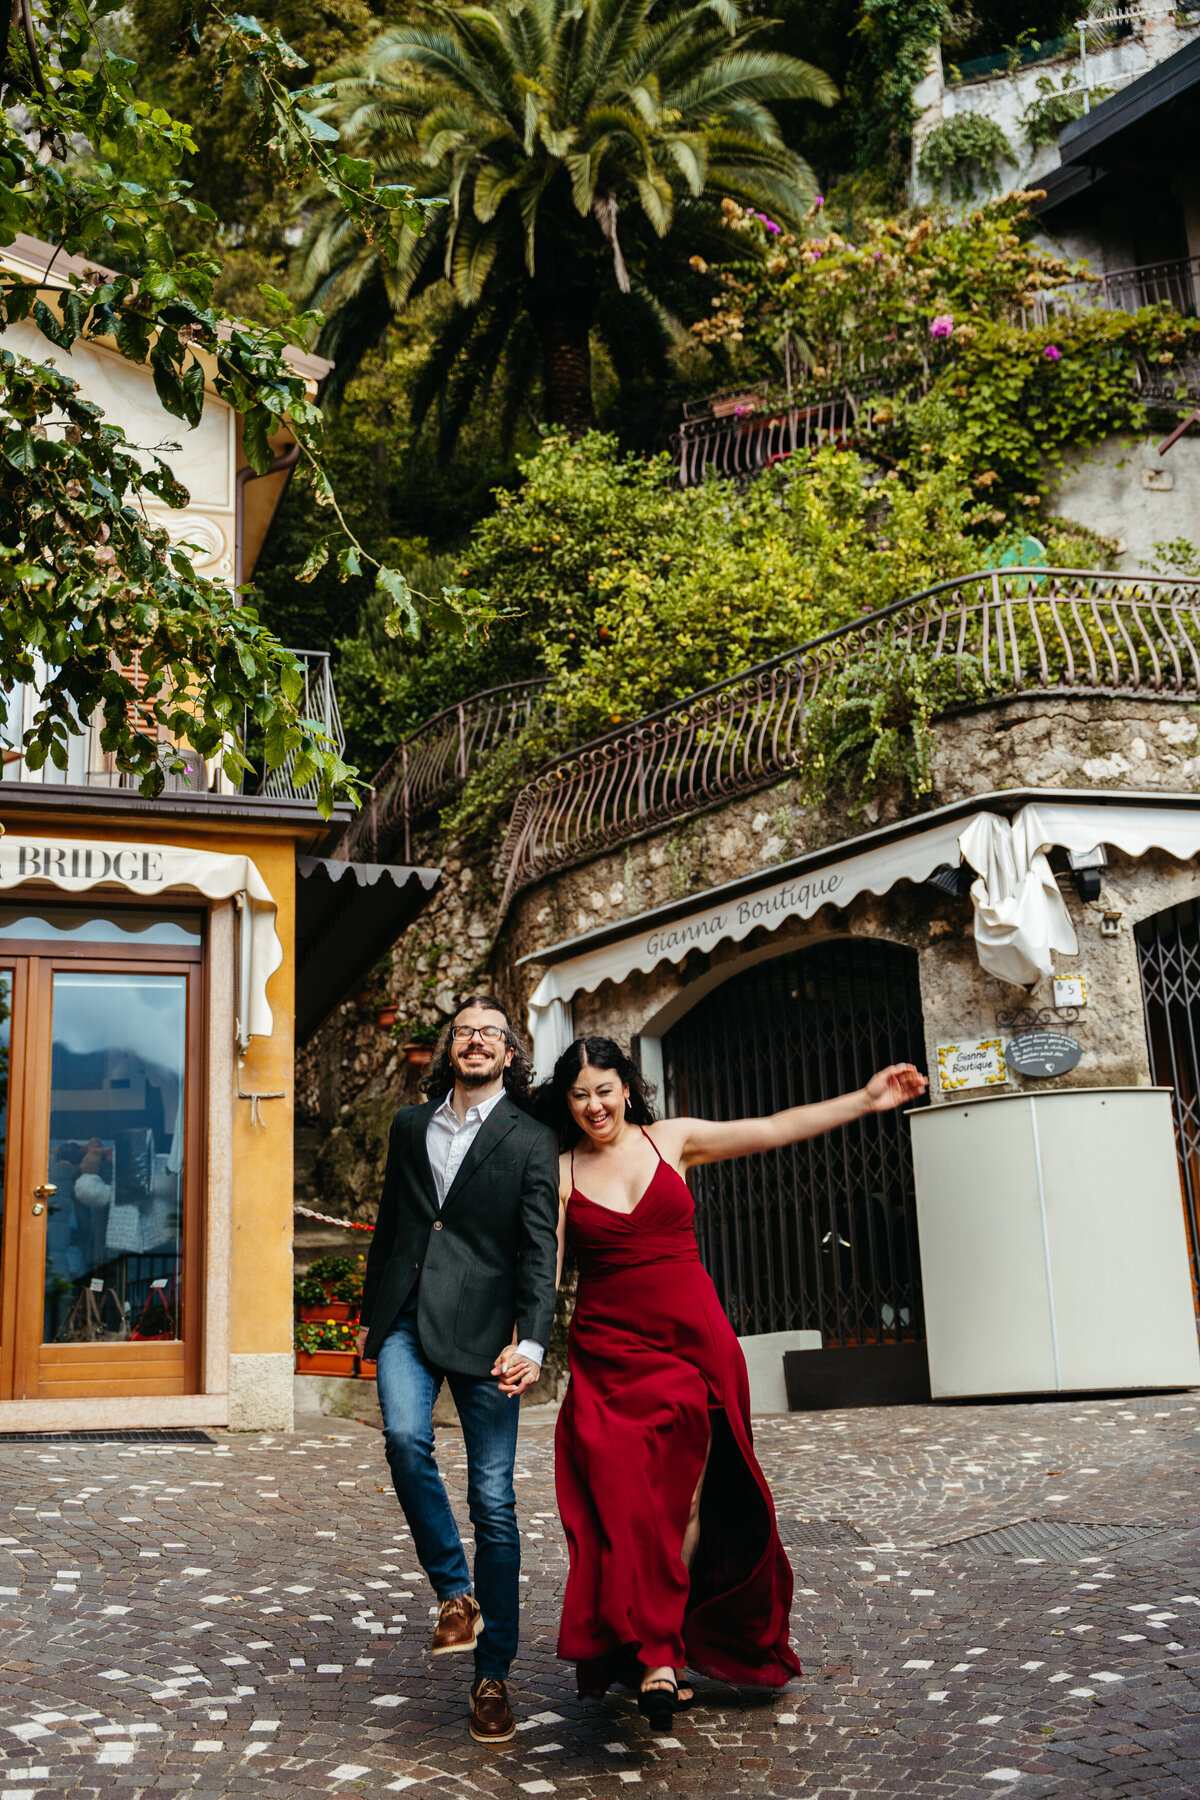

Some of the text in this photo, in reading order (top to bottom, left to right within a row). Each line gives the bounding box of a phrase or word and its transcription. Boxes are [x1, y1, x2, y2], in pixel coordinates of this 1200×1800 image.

[17, 846, 163, 881] BRIDGE
[646, 874, 844, 957] Gianna Boutique
[952, 1061, 993, 1074] Boutique
[956, 1051, 987, 1063] Gianna
